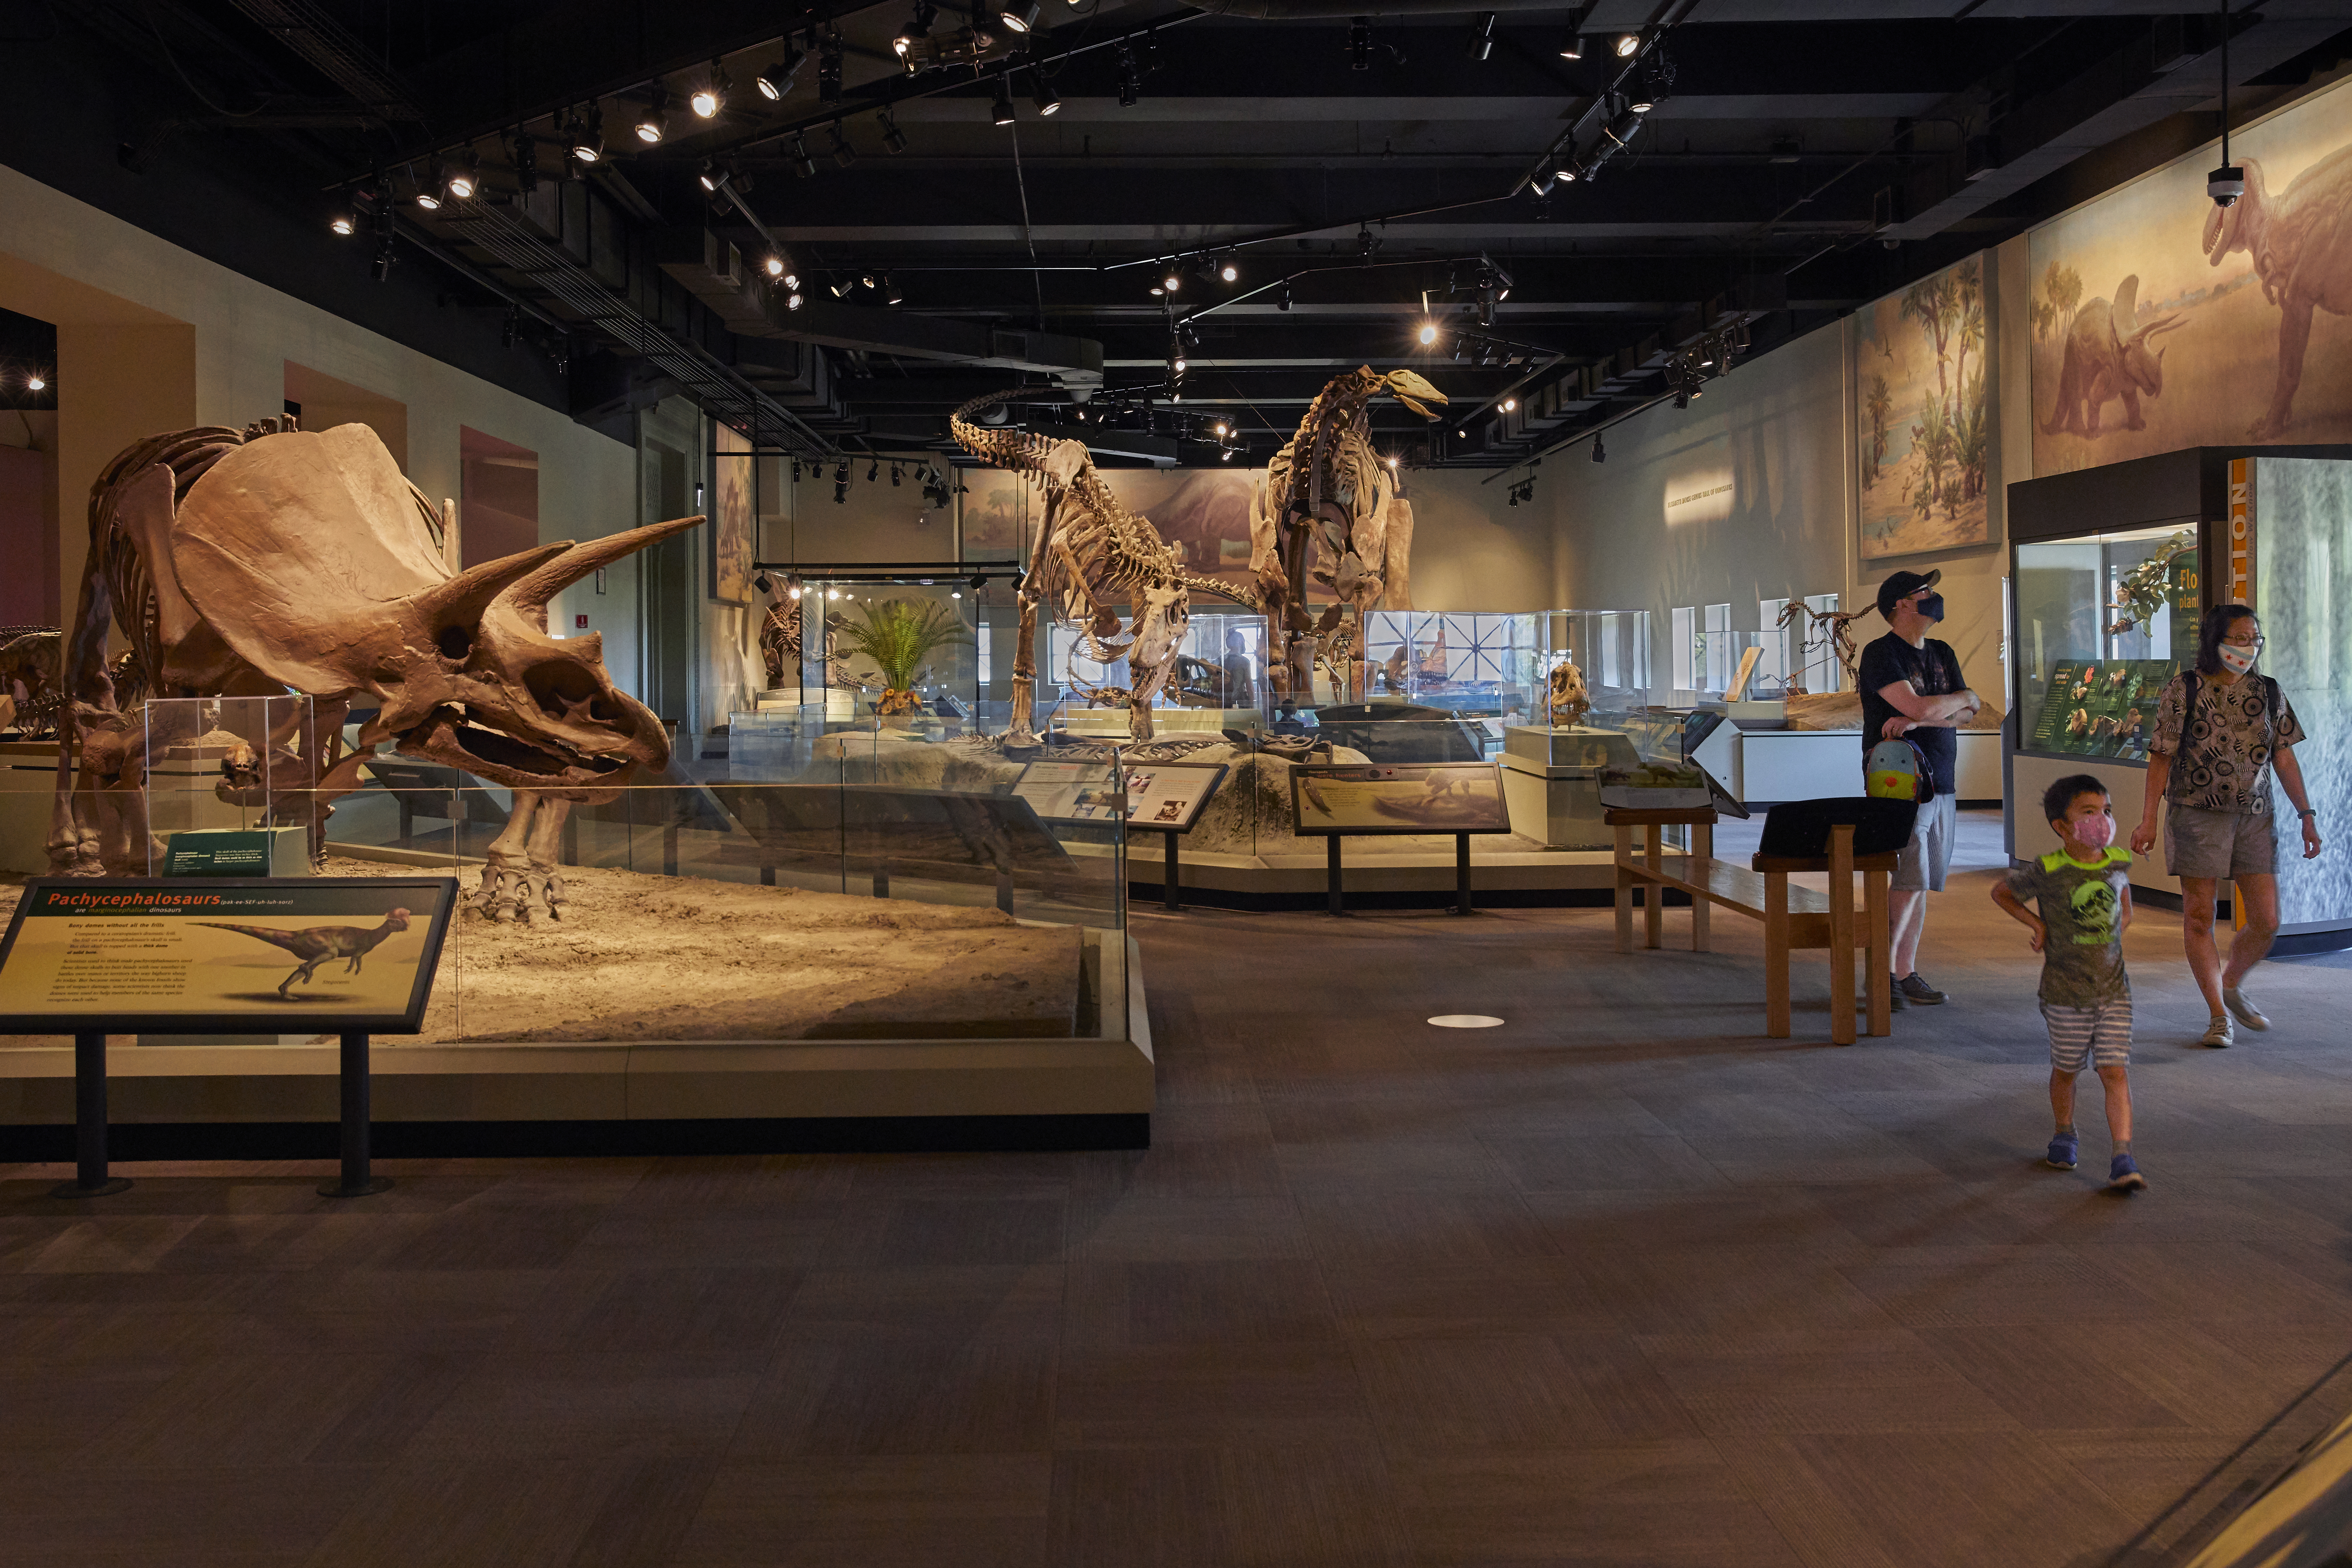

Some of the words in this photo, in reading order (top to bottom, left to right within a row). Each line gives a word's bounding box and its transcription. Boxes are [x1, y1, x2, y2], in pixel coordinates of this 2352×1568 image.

[1668, 498, 1682, 508] ELIZABETH
[1682, 495, 1691, 504] MORSE
[1691, 492, 1702, 501] GENIUS
[1715, 483, 1732, 494] DINOSAURS
[2248, 517, 2254, 532] We
[2232, 482, 2246, 606] TION
[2054, 672, 2067, 680] spread
[48, 892, 221, 908] Pachycephalosaurs
